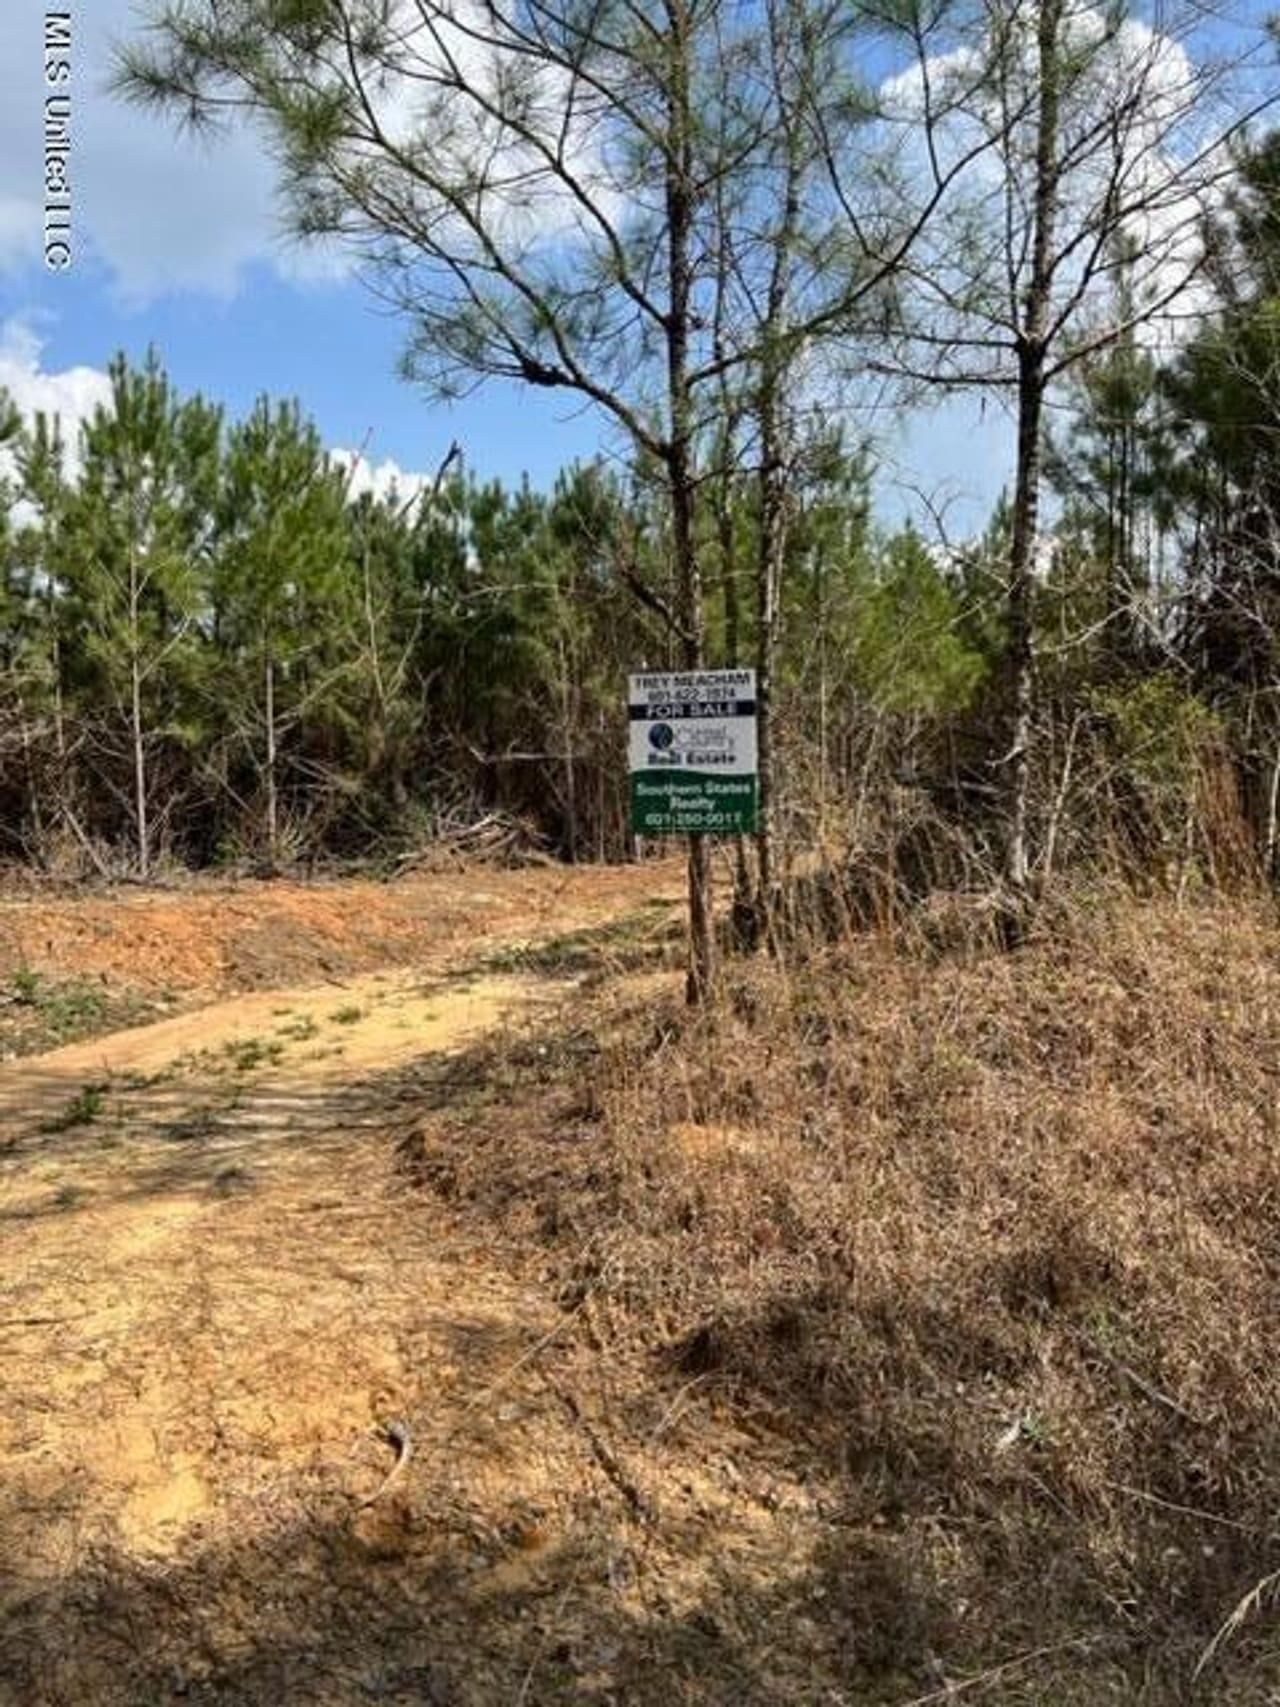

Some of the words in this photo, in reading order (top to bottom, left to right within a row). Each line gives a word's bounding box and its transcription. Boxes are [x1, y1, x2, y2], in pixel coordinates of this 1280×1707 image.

[646, 702, 684, 718] FOR
[689, 701, 737, 716] SALE
[686, 749, 737, 764] Estate
[636, 781, 702, 796] Southern
[704, 780, 751, 795] States
[669, 796, 716, 811] Realty
